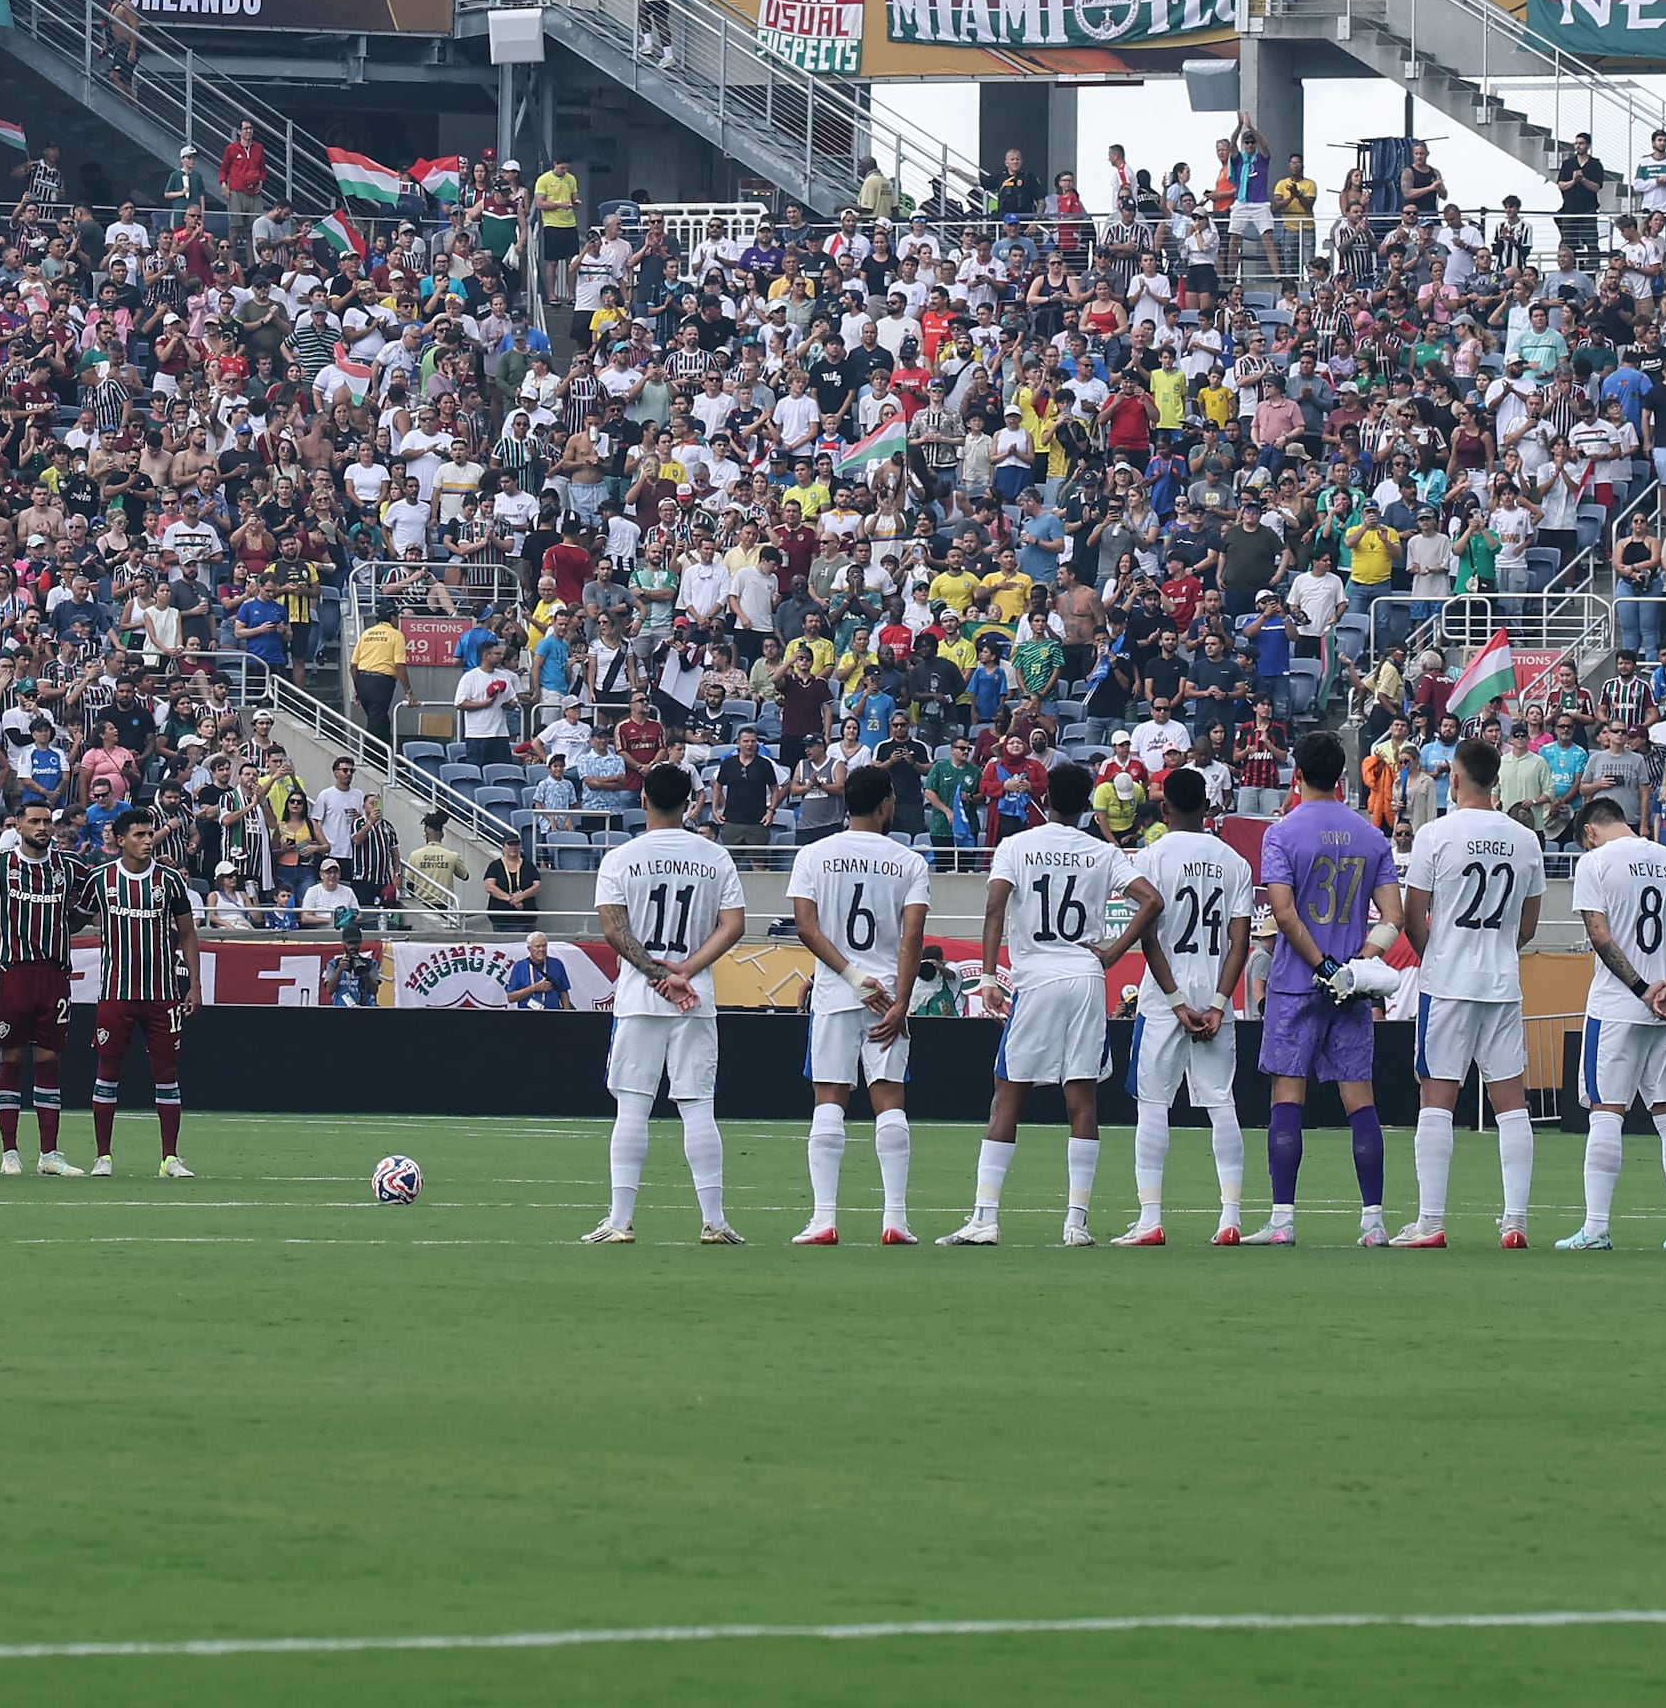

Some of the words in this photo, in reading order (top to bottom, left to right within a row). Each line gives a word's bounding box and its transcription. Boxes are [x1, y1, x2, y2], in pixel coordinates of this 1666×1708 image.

[757, 28, 859, 71] SUSPECTS
[410, 622, 464, 634] SECTIONS
[1511, 655, 1552, 667] TIONS
[866, 719, 880, 731] 23
[1321, 831, 1351, 846] BONO
[1466, 840, 1514, 857] SERGEJ
[419, 861, 449, 870] SERVICES
[423, 854, 444, 862] GUEST
[1025, 852, 1081, 868] NASSER
[1086, 855, 1099, 869] D.
[629, 864, 645, 880] M.
[649, 860, 717, 881] LEONARDO
[822, 858, 869, 874] RENAN
[873, 860, 904, 878] LODI
[1183, 862, 1223, 879] MOTEB
[8, 887, 64, 904] SUPERBET
[1308, 855, 1367, 925] 37
[1454, 861, 1515, 930] 22
[109, 905, 162, 919] SUPERBET
[846, 882, 876, 951] 6
[1032, 874, 1087, 943] 16
[644, 883, 695, 953] 11
[1174, 885, 1224, 956] 24
[1636, 885, 1662, 955] 8
[167, 1006, 183, 1034] 12
